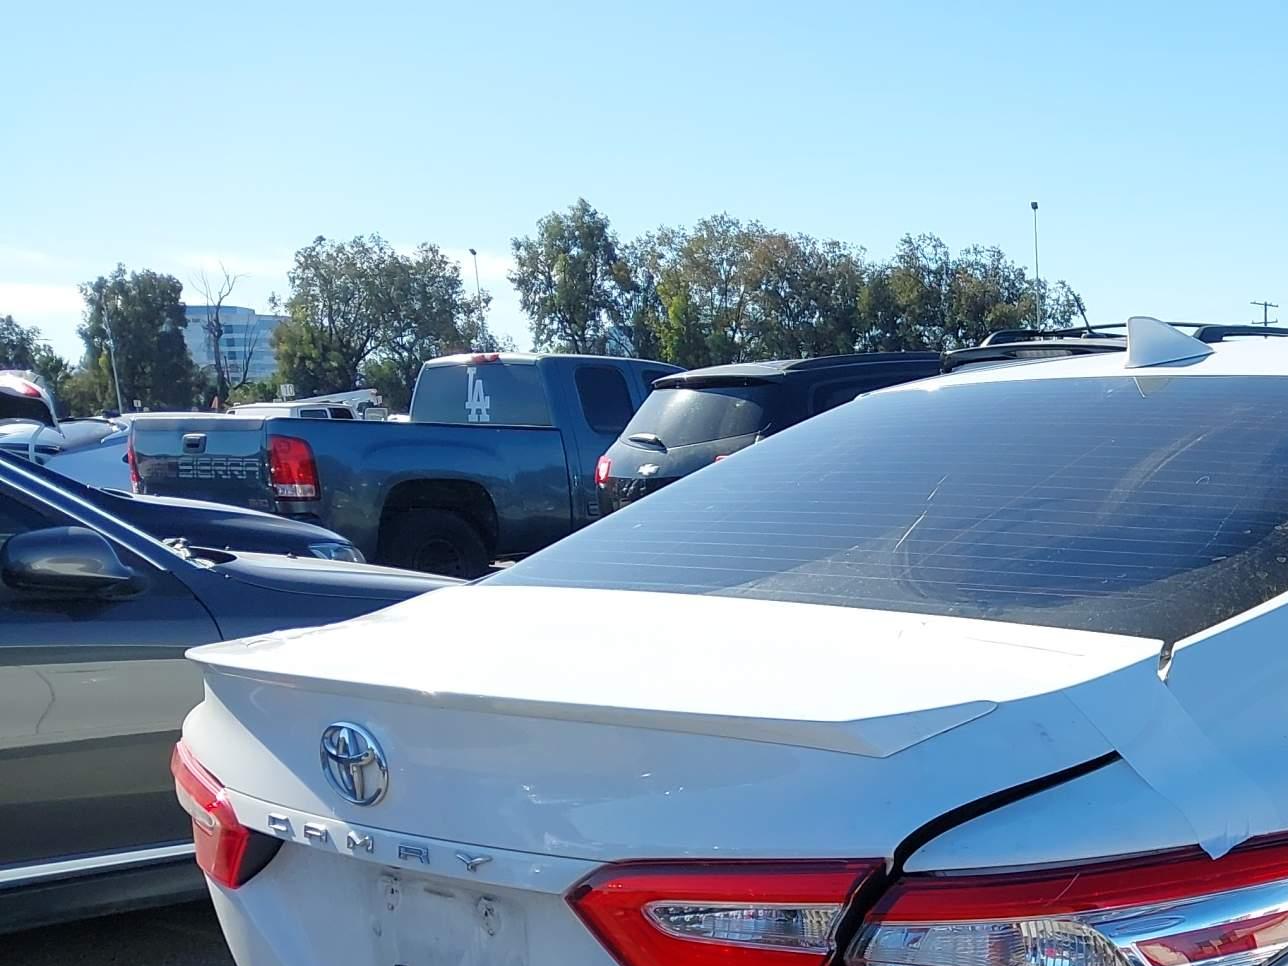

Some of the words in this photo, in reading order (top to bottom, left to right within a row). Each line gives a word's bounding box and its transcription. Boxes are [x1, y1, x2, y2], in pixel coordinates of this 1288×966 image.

[466, 367, 490, 422] LA
[178, 457, 260, 479] SIERRA
[268, 812, 493, 872] CAMRY
